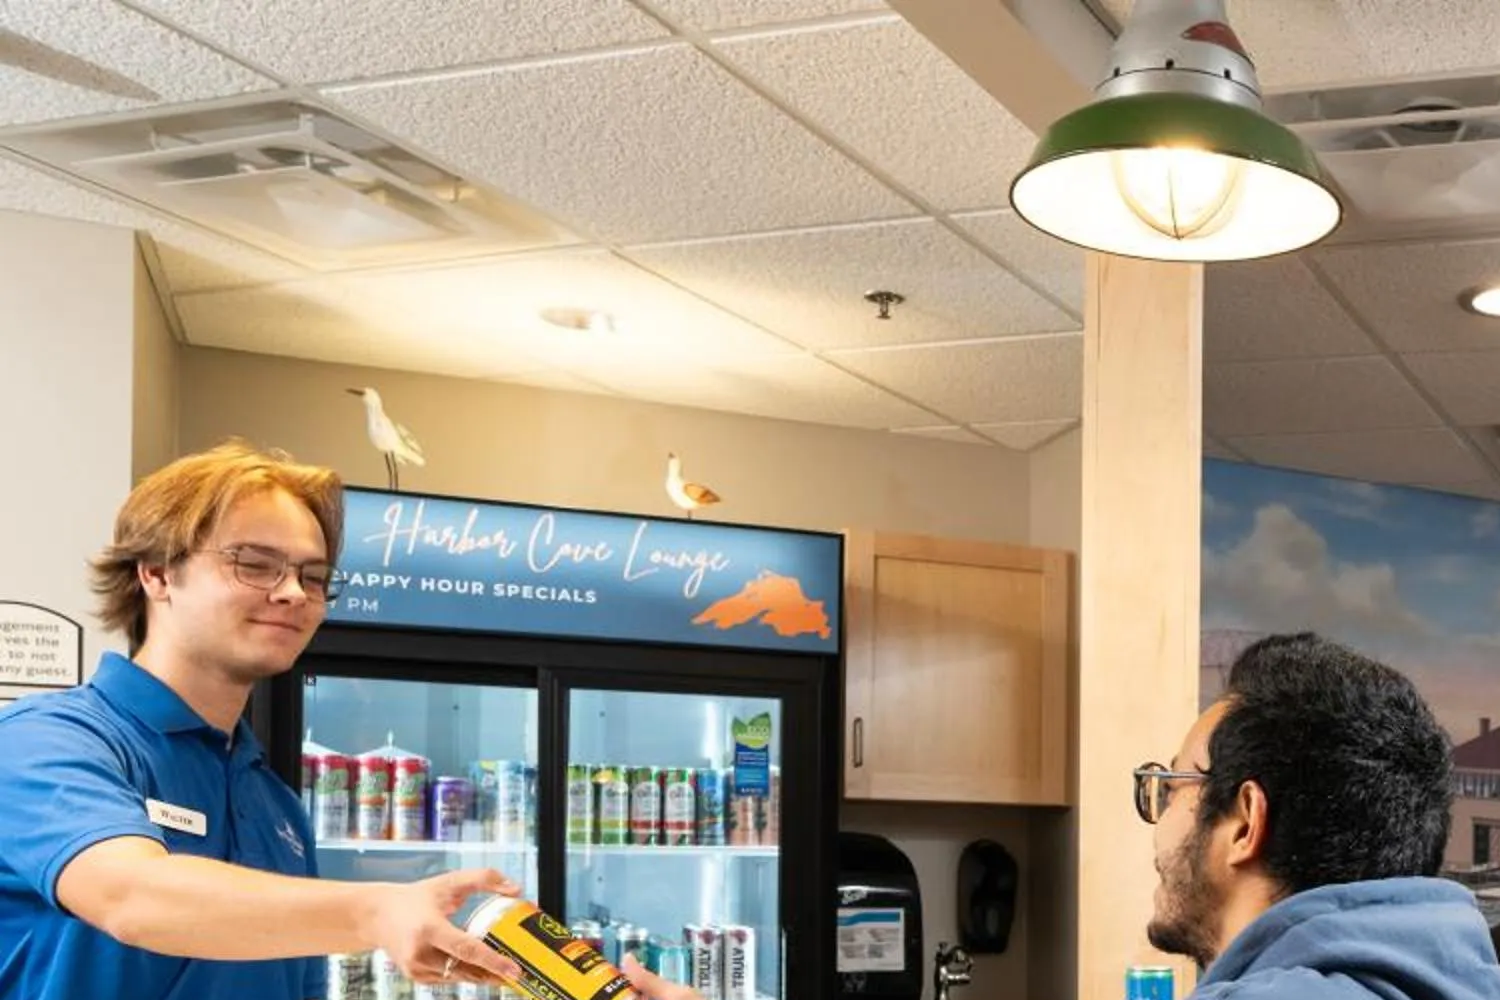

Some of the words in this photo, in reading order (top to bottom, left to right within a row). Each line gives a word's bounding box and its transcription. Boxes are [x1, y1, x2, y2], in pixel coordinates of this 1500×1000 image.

[363, 500, 518, 567] Harbor
[527, 512, 615, 573] Cove
[623, 521, 731, 599] Lounge
[347, 597, 379, 613] PM
[420, 577, 485, 596] HOUR
[493, 583, 598, 605] SPECIALS
[31, 652, 57, 662] not
[731, 947, 745, 989] TRULY
